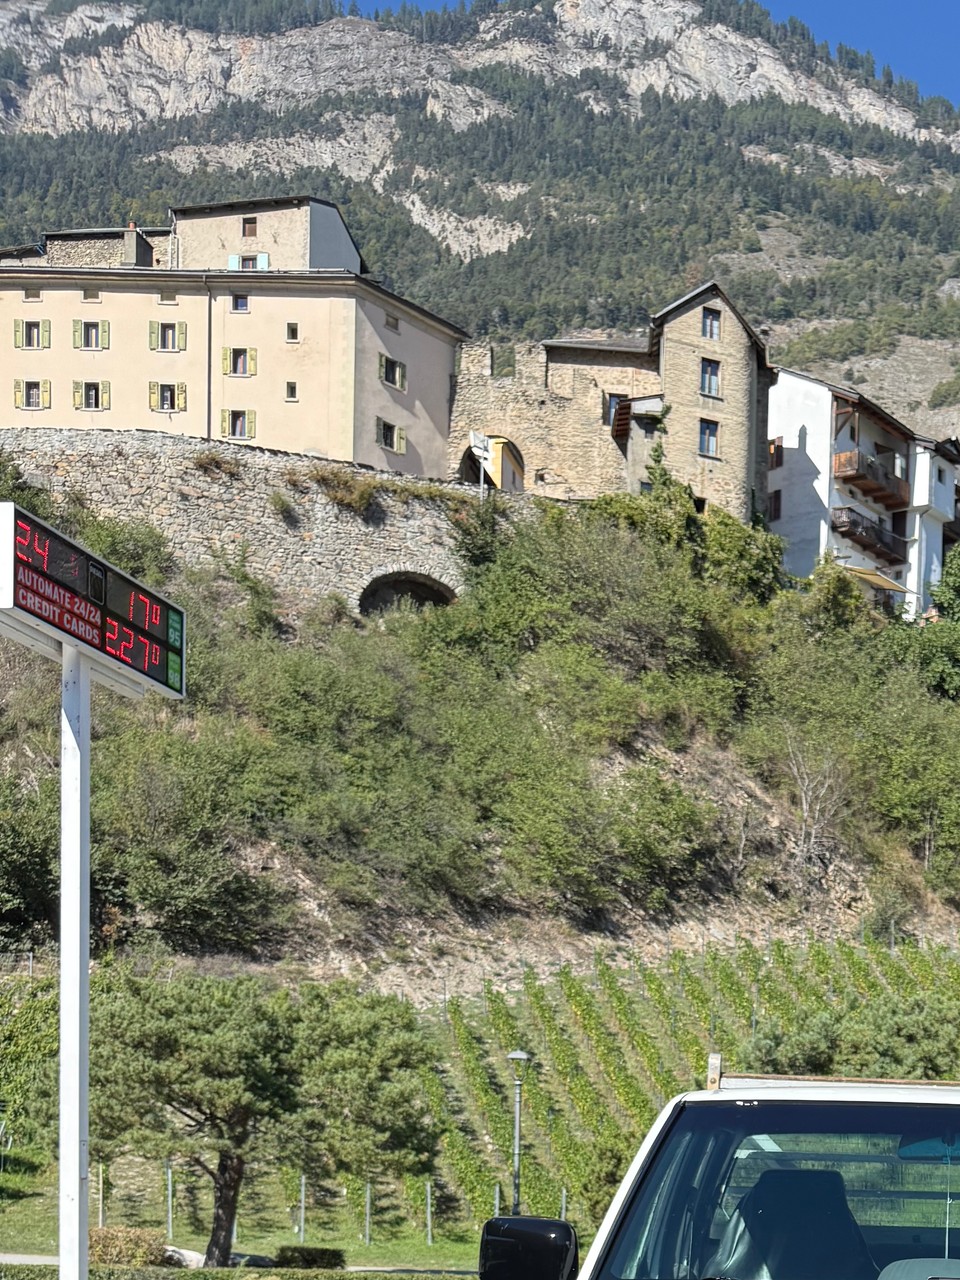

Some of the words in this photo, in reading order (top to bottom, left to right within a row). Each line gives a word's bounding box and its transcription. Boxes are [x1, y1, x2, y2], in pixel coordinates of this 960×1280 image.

[18, 566, 71, 609] AUTOMATE
[73, 598, 101, 626] 24/24
[19, 588, 60, 622] CREDIT
[64, 613, 99, 644] CARDS
[168, 628, 181, 649] 95
